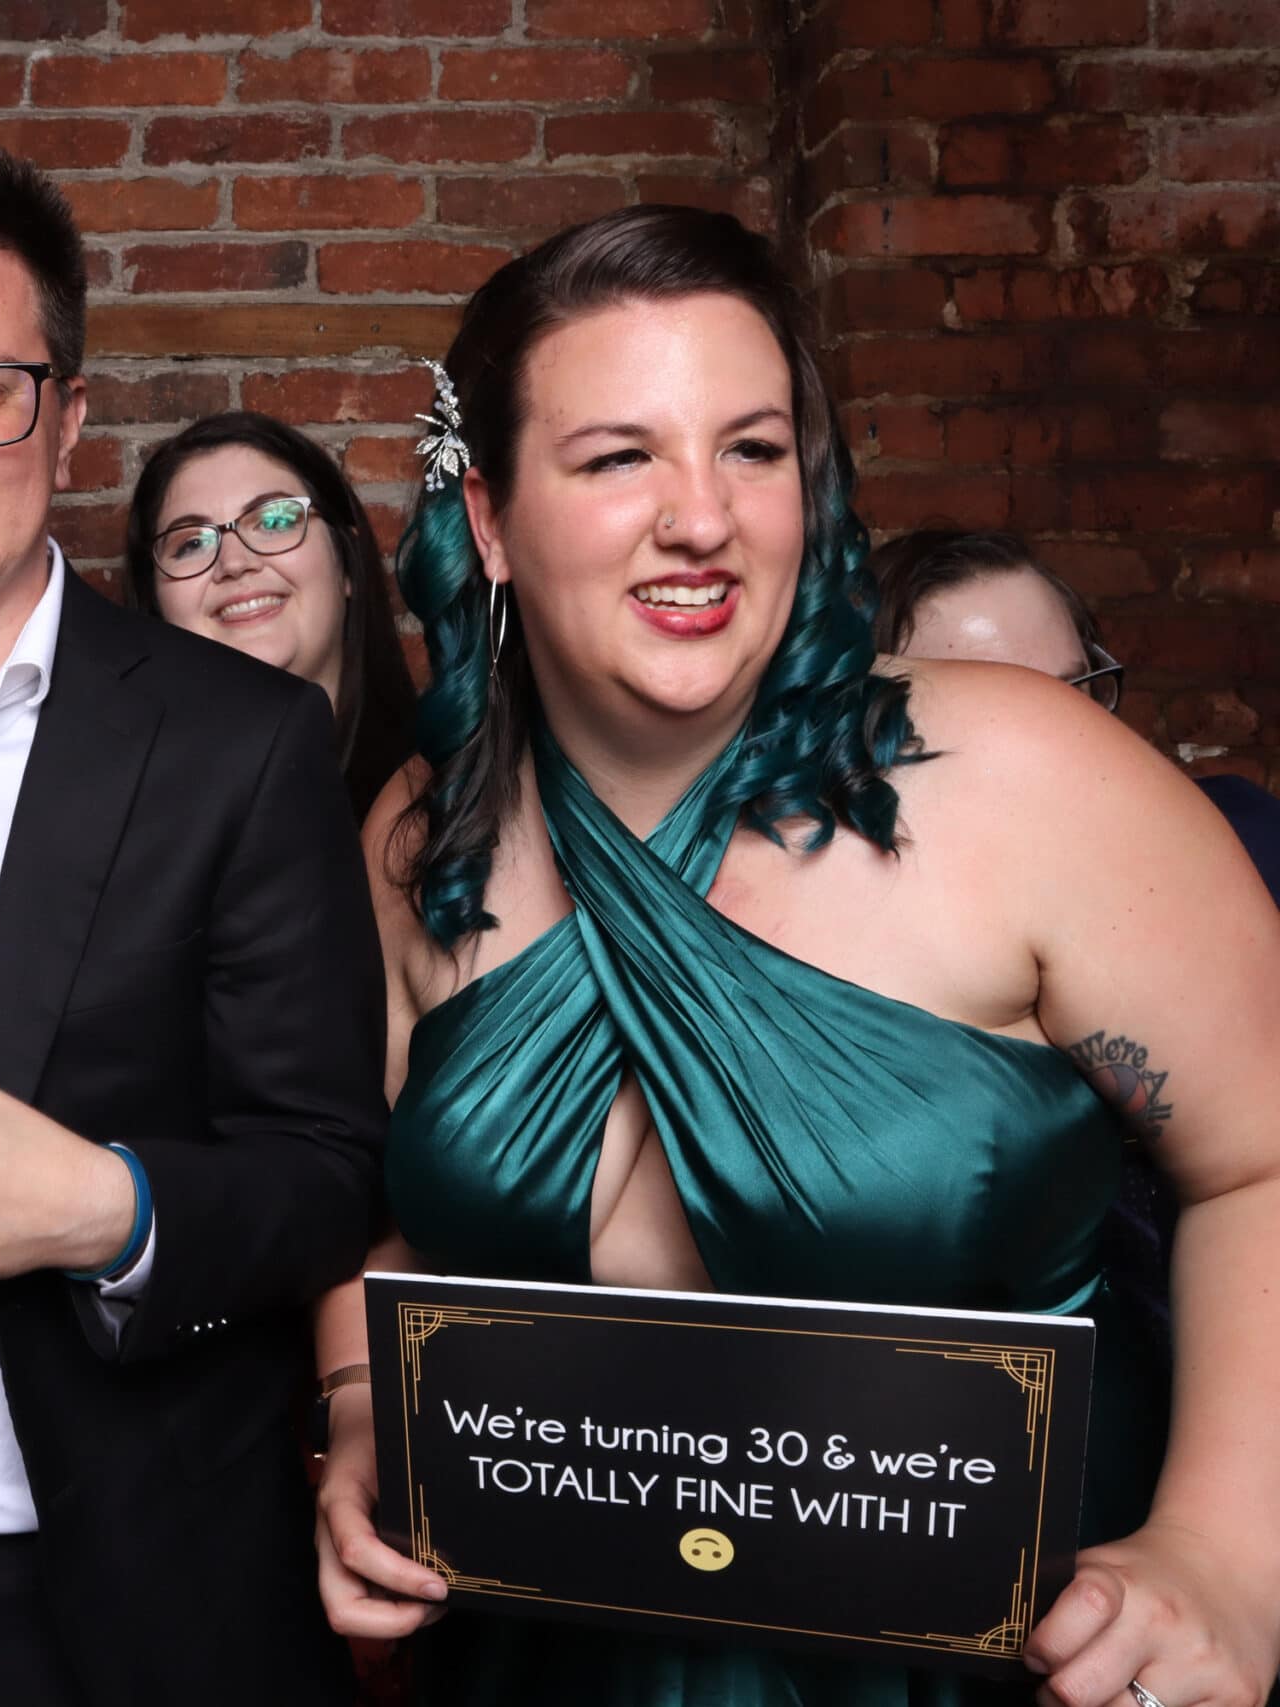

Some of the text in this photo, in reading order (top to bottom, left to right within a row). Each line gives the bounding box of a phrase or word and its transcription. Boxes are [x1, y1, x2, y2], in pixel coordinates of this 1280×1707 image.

[443, 1400, 996, 1484] We're turning 30 & we're
[469, 1456, 967, 1538] TOTALLY FINE WITH IT
